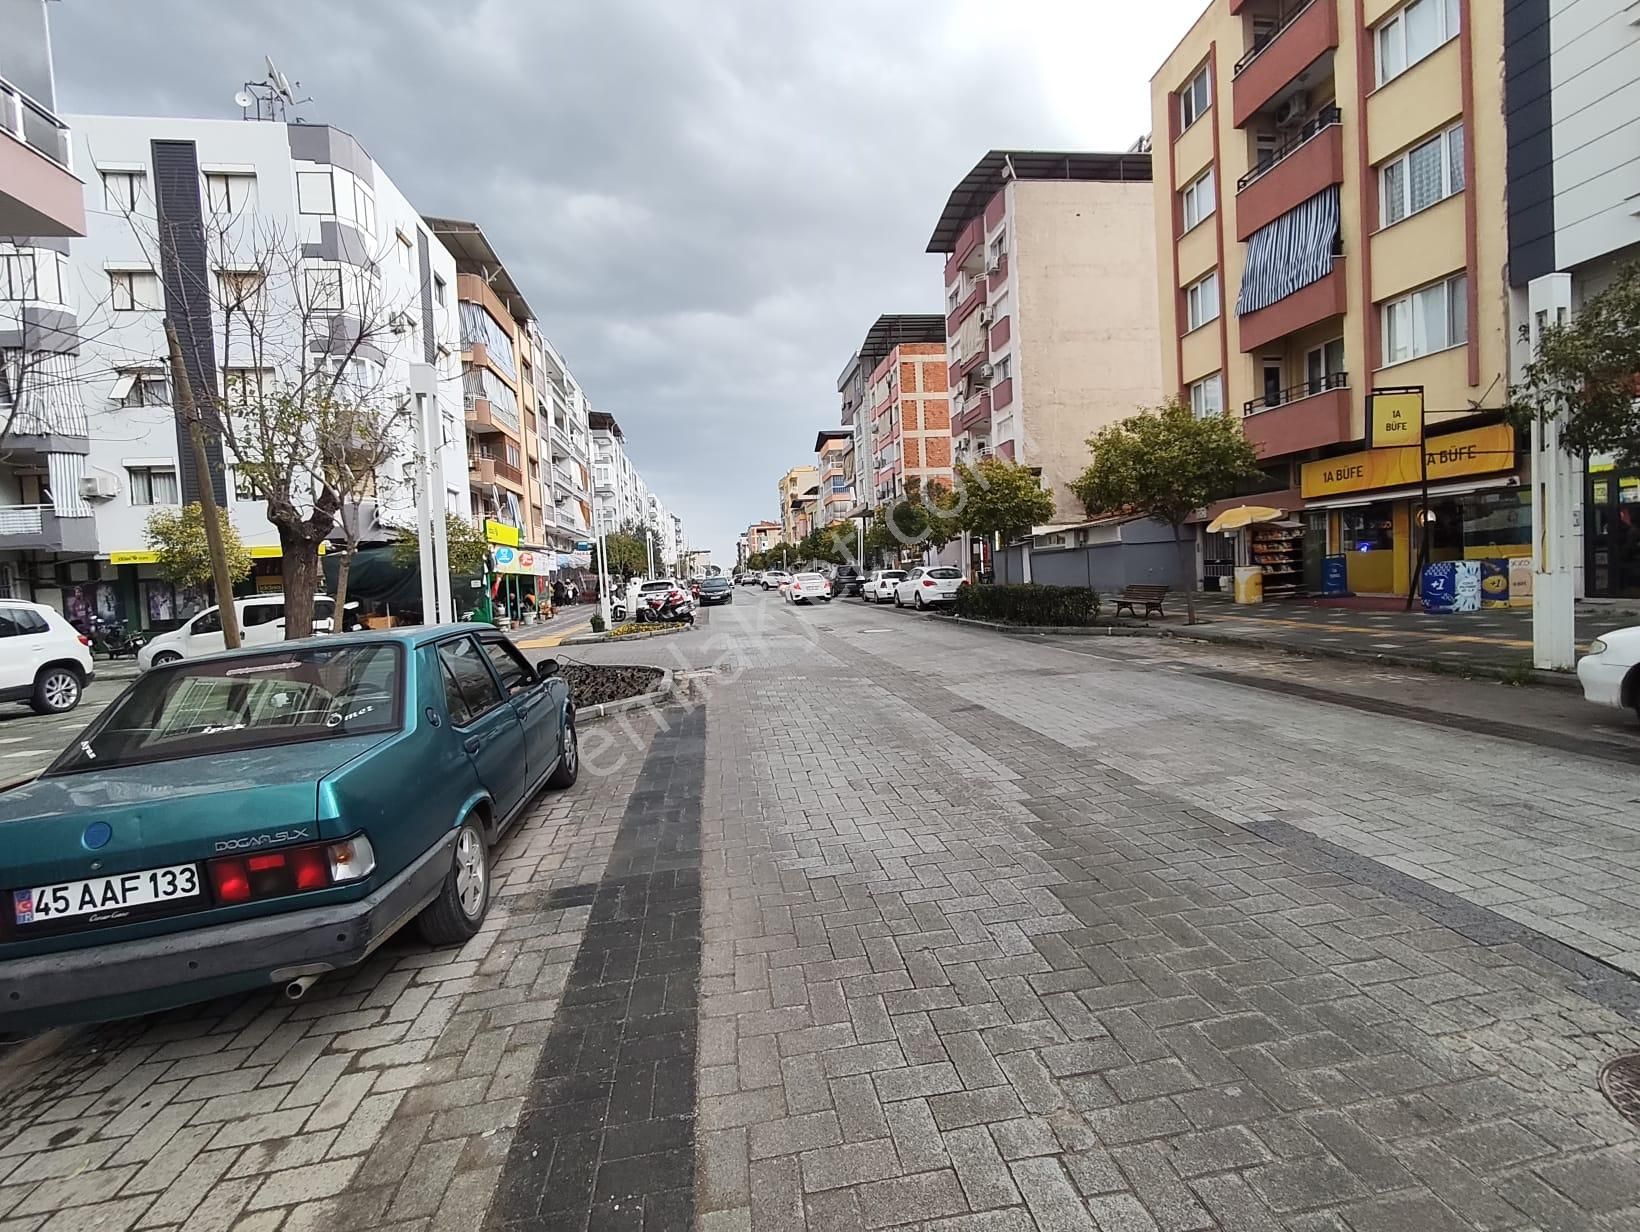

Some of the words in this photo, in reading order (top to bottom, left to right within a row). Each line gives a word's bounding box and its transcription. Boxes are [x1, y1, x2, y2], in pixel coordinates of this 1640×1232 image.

[1392, 410, 1402, 419] 1A
[1385, 421, 1408, 432] BÜFE
[1439, 445, 1477, 464] BÜFE
[1323, 471, 1334, 484] 1A
[1336, 465, 1364, 481] BÜFE
[34, 886, 71, 916] 45
[78, 874, 141, 911] AAF
[149, 866, 197, 899] 133
